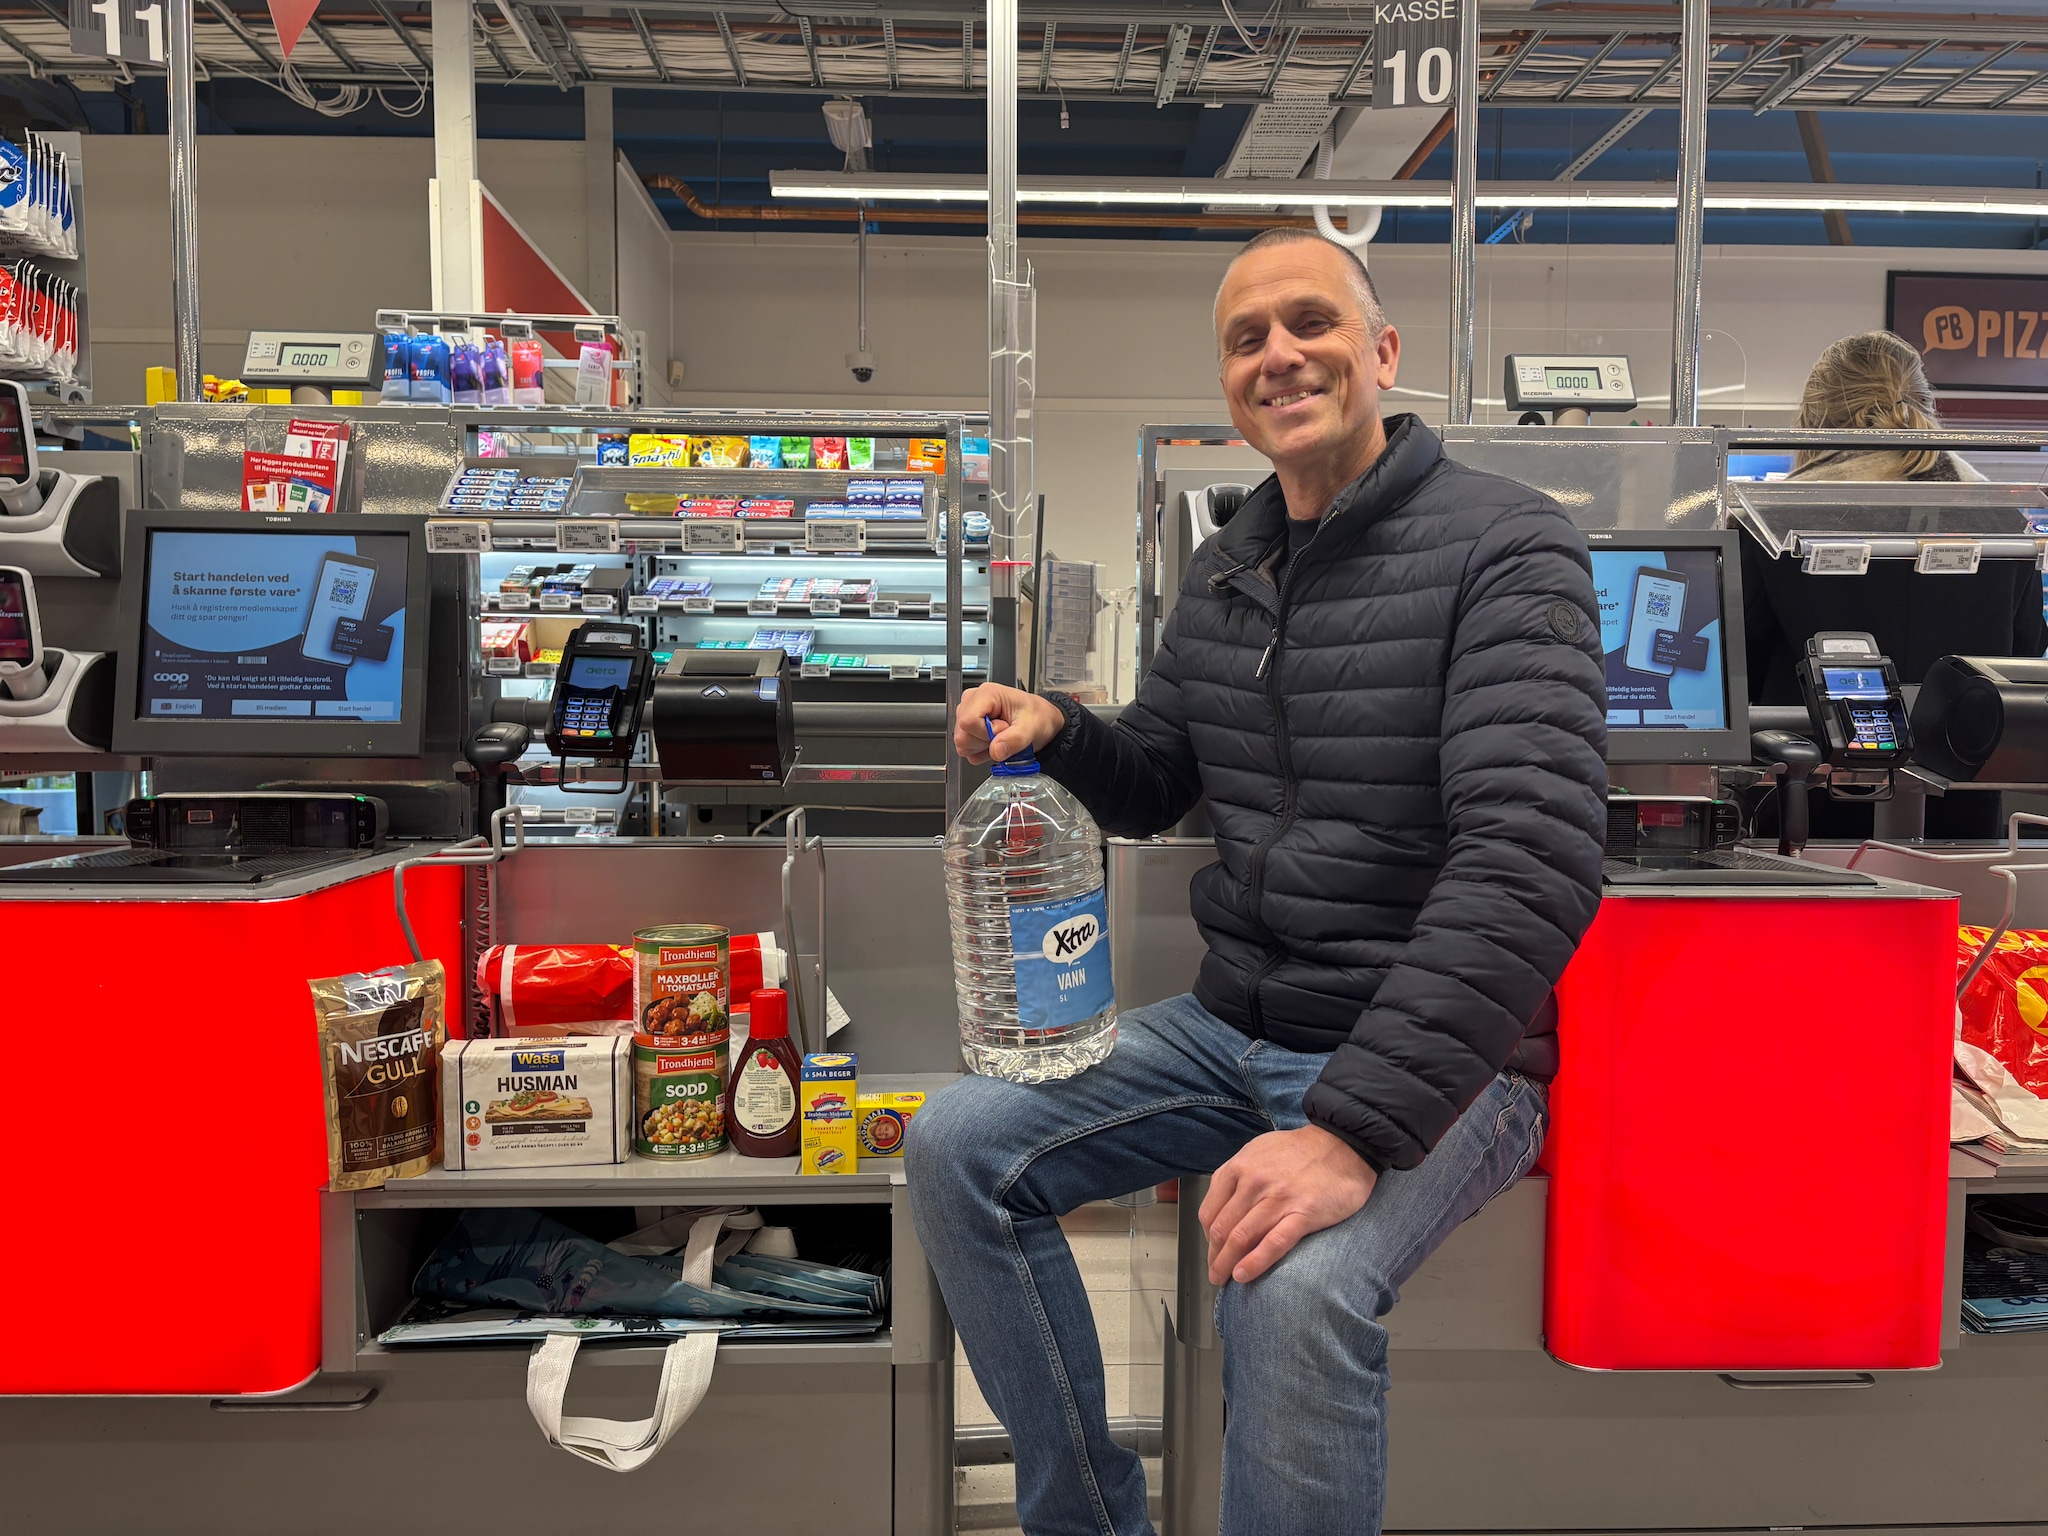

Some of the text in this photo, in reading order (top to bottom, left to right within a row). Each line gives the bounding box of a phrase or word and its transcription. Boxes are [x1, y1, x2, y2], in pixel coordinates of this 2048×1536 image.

[1375, 0, 1456, 24] KASSE
[92, 0, 163, 62] 11
[1383, 47, 1453, 105] 10
[1935, 313, 1964, 344] PB
[630, 449, 682, 464] Smash!
[262, 458, 282, 466] legges
[282, 460, 329, 471] produktkortene
[261, 466, 292, 474] Reseptfrie
[292, 469, 326, 478] legemidler.
[173, 571, 290, 583] Start handelen ved
[172, 584, 179, 595] å
[183, 586, 227, 596] skanne
[230, 587, 266, 596] første
[1595, 588, 1608, 597] ed
[171, 603, 191, 611] Husk
[200, 604, 238, 612] registrere
[240, 605, 297, 613] medlemskapet
[1598, 602, 1619, 611] are
[218, 614, 248, 622] penger!
[585, 667, 617, 675] aera
[153, 672, 189, 684] coop
[241, 675, 258, 683] valgt
[277, 676, 303, 684] tilfeldig
[1053, 922, 1095, 957] Xtra
[662, 949, 716, 962] Trondhjems
[657, 971, 719, 984] MAXBOLLER
[1057, 968, 1086, 991] VANN
[666, 981, 716, 992] TOMATSAUS
[653, 1036, 660, 1046] 5
[681, 1036, 698, 1046] 3-4
[659, 1056, 714, 1070] Trondhjems
[367, 1056, 426, 1084] GULL
[811, 1070, 827, 1078] SMÅ
[828, 1070, 851, 1078] BEGER
[497, 1074, 577, 1093] HUSMAN
[665, 1082, 708, 1098] SODD
[383, 1133, 404, 1143] FYLDIG
[404, 1128, 423, 1138] AROMA
[350, 1140, 373, 1149] 100%
[382, 1138, 415, 1149] BALANSERT
[652, 1144, 659, 1153] 4
[679, 1144, 696, 1154] 2-3
